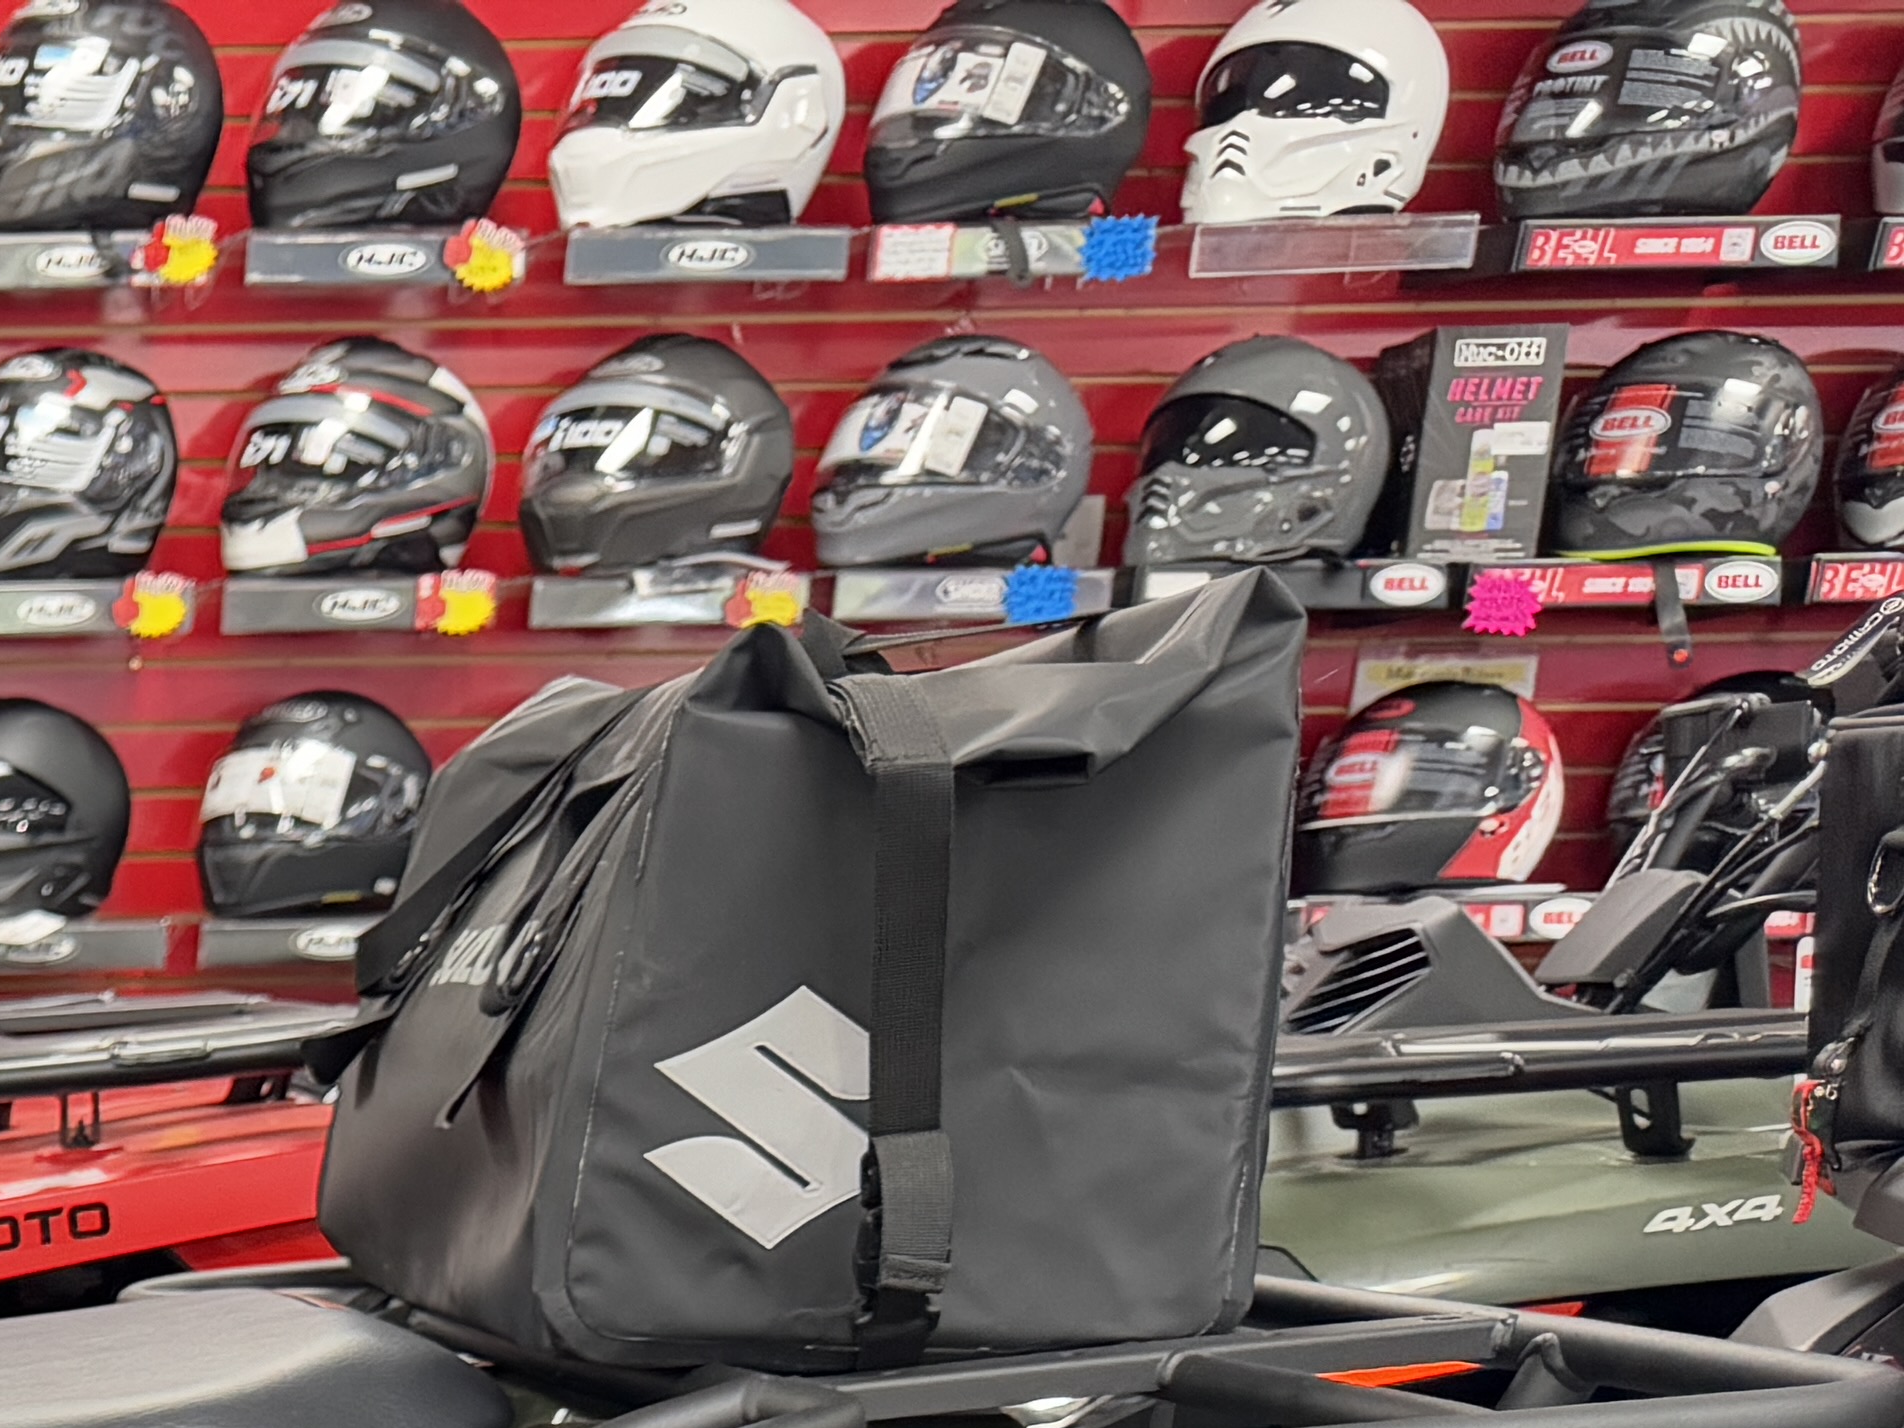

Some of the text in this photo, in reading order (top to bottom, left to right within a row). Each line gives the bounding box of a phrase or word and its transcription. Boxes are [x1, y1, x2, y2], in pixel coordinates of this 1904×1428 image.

[1773, 235, 1821, 251] BELL
[1459, 341, 1541, 362] Muc-Off
[1448, 376, 1543, 403] HELMET
[1601, 416, 1653, 431] BELL
[1383, 576, 1431, 592] BELL
[1716, 575, 1763, 589] BELL
